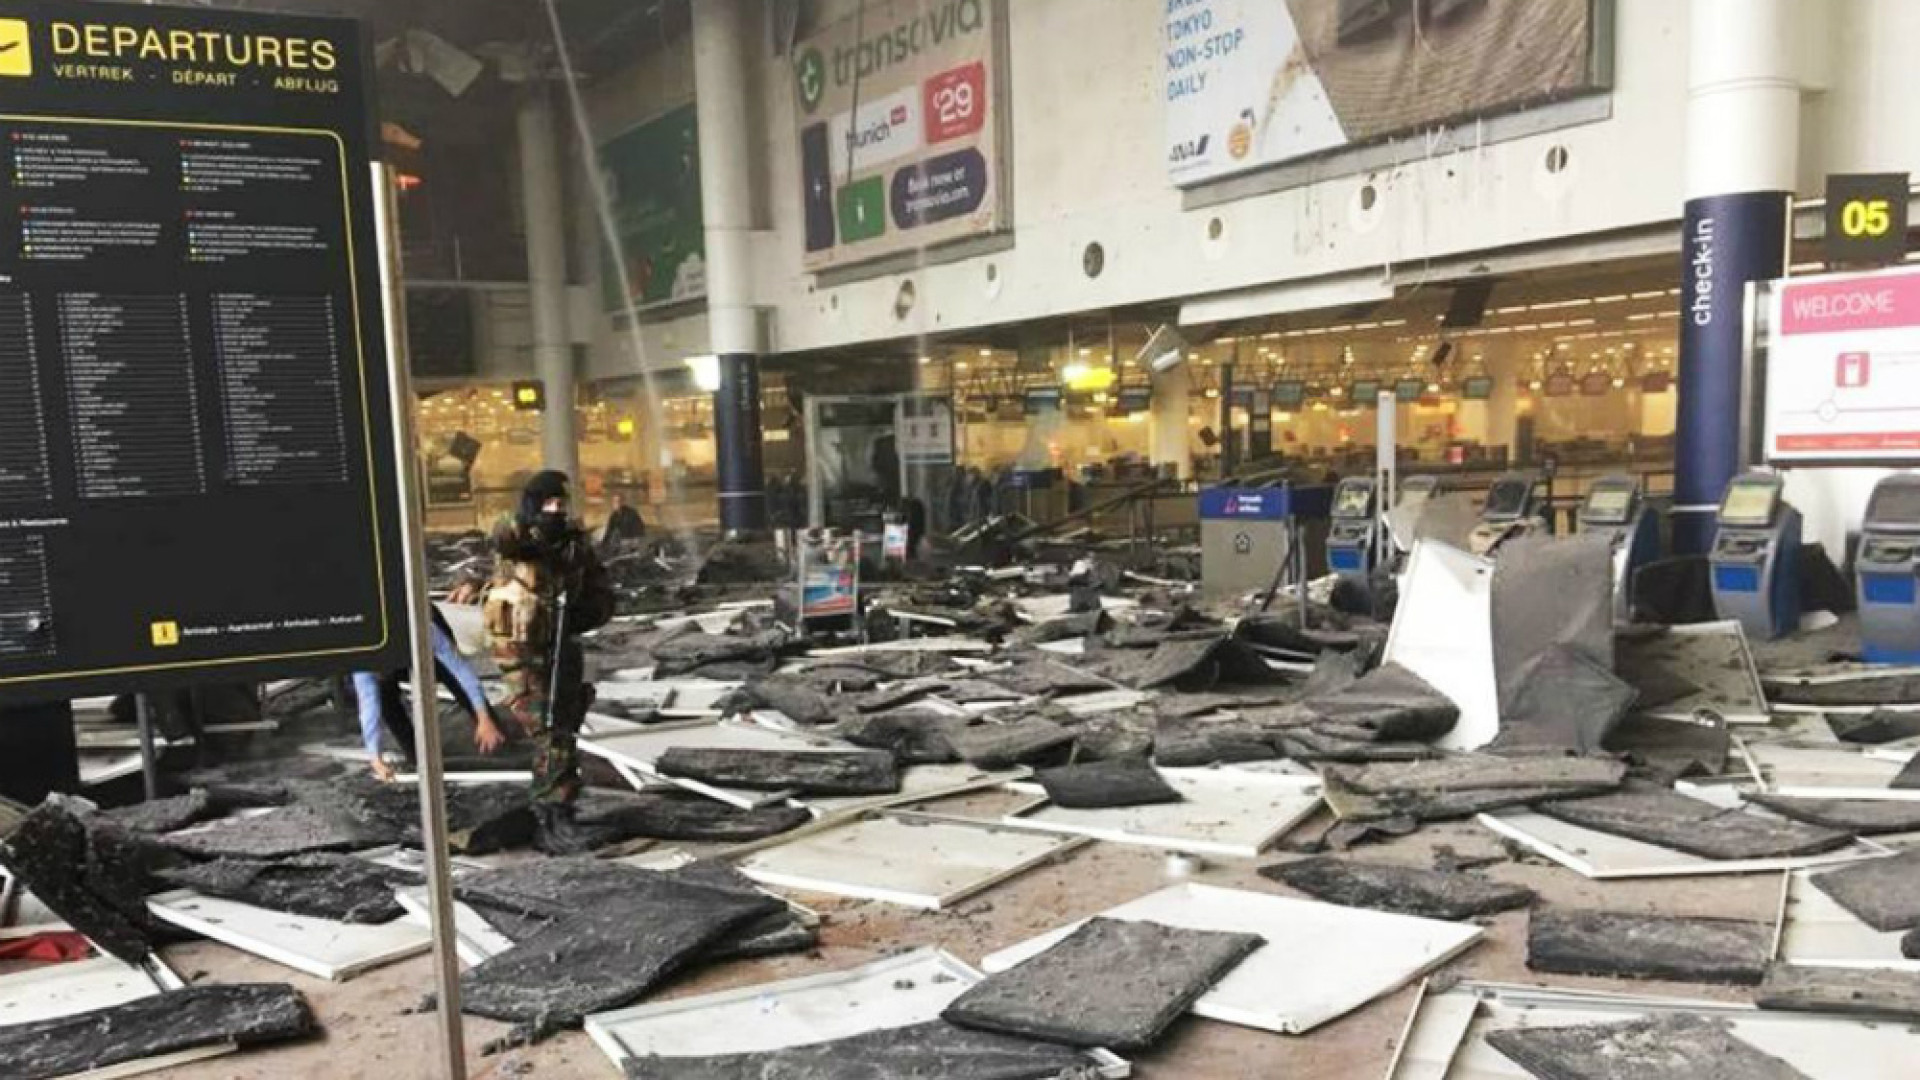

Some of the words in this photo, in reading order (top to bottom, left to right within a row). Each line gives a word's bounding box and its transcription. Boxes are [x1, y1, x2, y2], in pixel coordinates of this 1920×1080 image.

[1166, 8, 1212, 41] TOKYO
[51, 22, 337, 72] DEPARTURES
[1165, 27, 1243, 69] NON-STOP
[53, 64, 134, 82] VERTREK
[172, 66, 237, 88] DÉPART
[274, 76, 339, 93] ABFLUG
[1167, 71, 1206, 100] DAILY
[1841, 200, 1890, 236] 05
[1691, 217, 1713, 325] check-in
[1792, 289, 1895, 320] WELCOME
